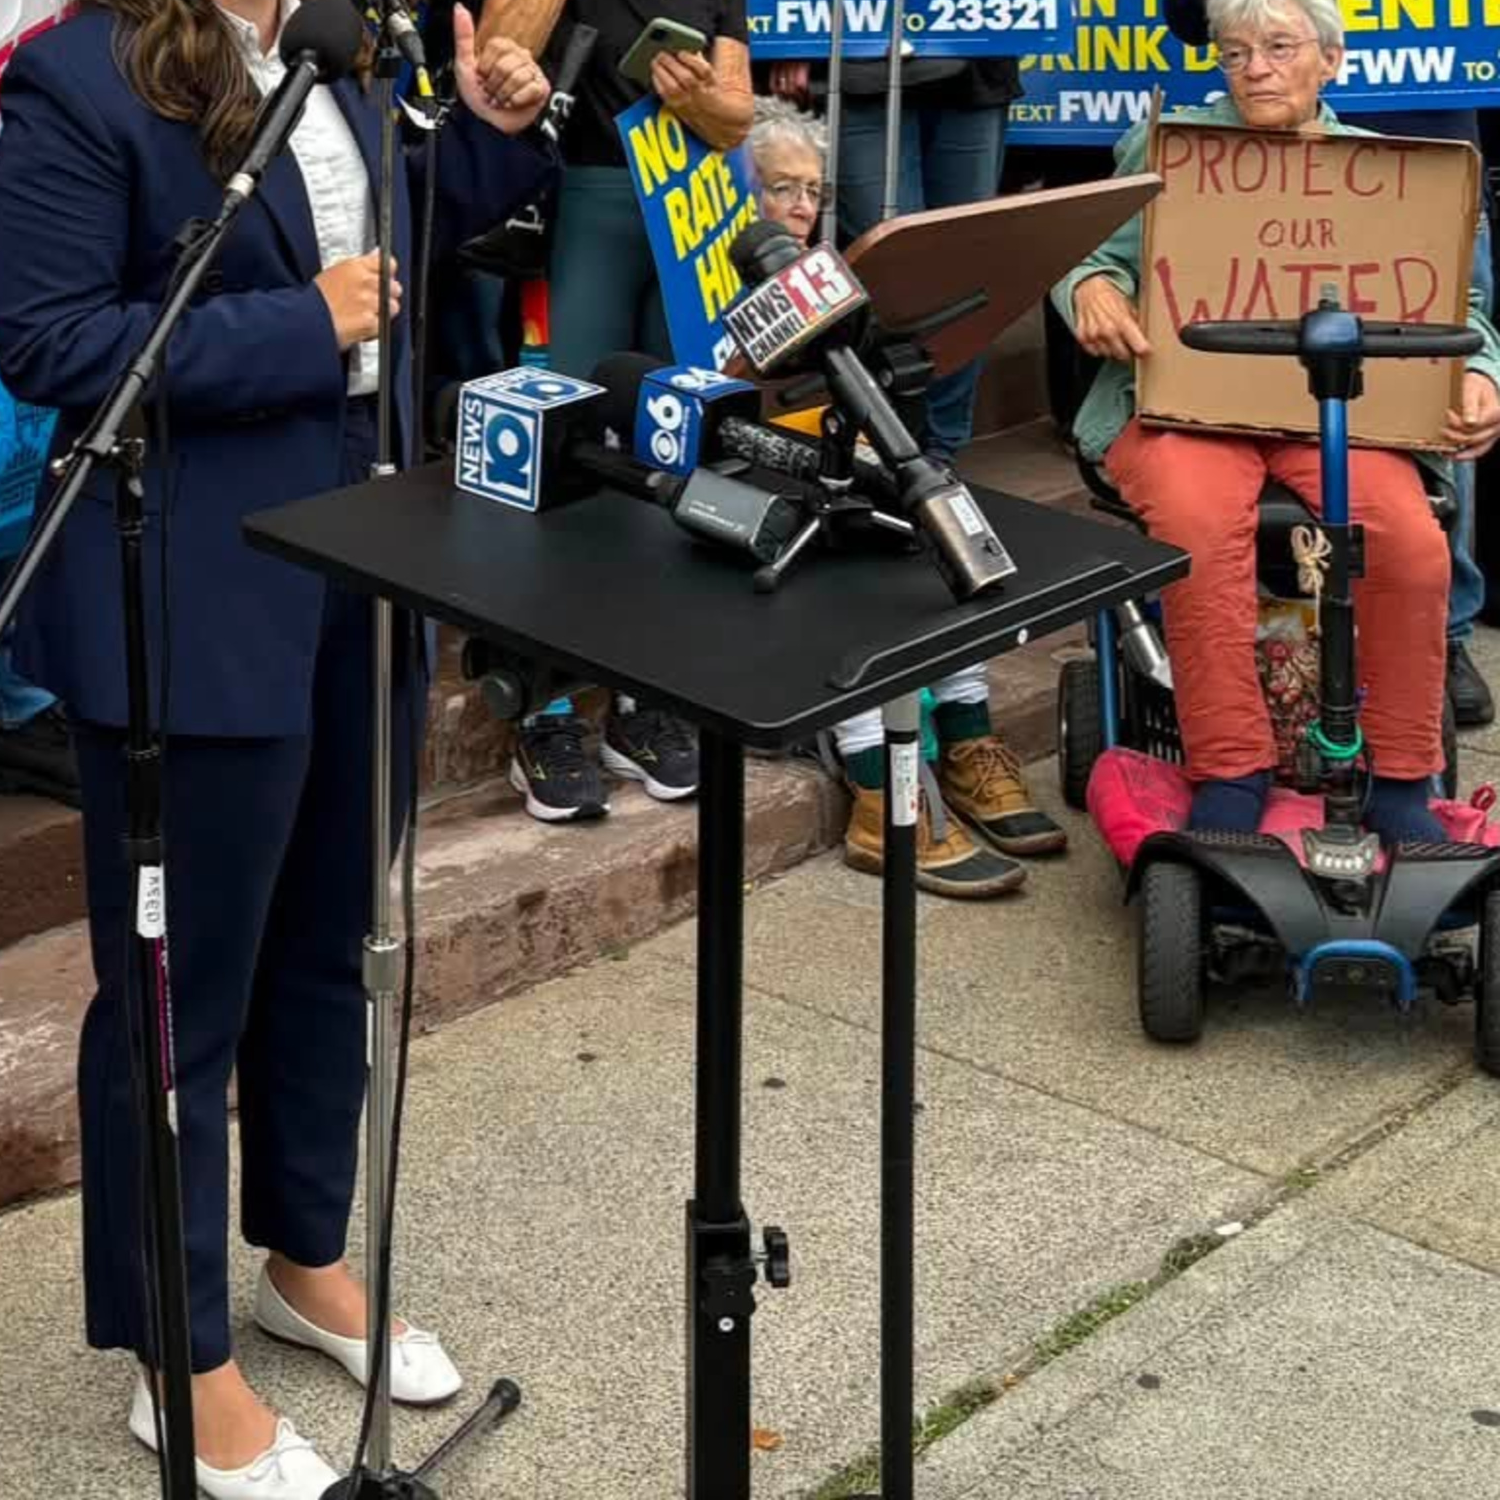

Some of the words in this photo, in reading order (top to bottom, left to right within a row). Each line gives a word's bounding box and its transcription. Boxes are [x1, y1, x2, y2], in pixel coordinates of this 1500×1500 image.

[1335, 47, 1456, 86] FWW
[1461, 61, 1495, 82] TO
[1008, 105, 1055, 123] TEXT
[628, 107, 688, 196] NO
[1160, 132, 1422, 200] PROTECT
[664, 152, 738, 262] RATE
[1257, 217, 1338, 249] OUR
[729, 283, 794, 345] NEWS
[786, 249, 854, 319] 13
[749, 311, 806, 362] CHANNEL
[461, 396, 483, 485] NEWS
[646, 393, 683, 432] 6
